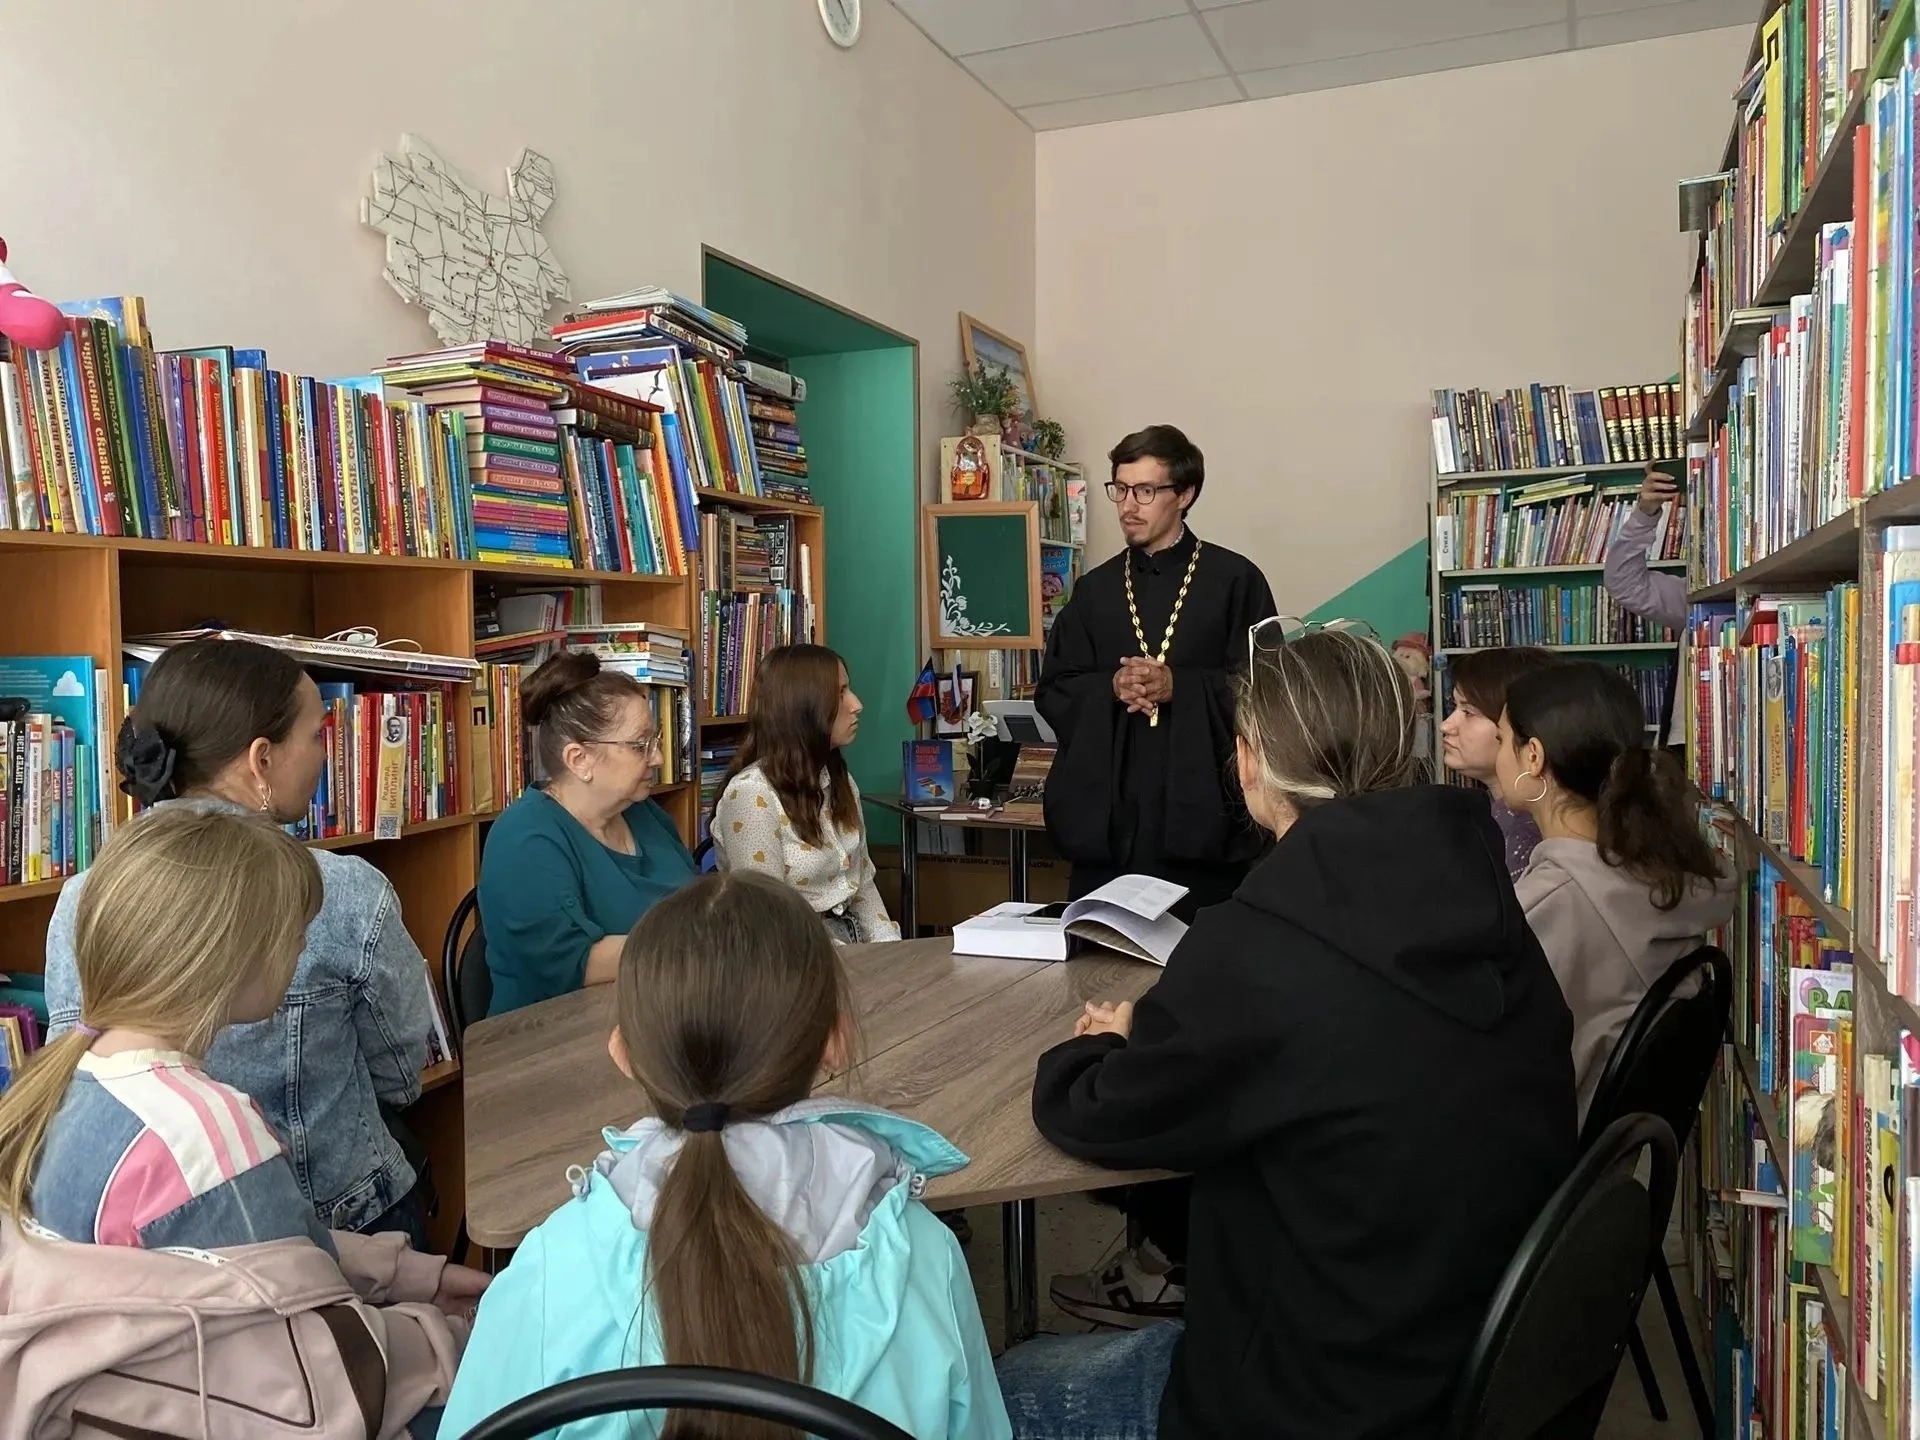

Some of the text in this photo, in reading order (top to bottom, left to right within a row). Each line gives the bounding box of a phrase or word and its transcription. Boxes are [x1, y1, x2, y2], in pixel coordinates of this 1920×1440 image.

[99, 328, 112, 378] СКАЗОК
[506, 343, 527, 355] Наши
[40, 360, 53, 396] КНИГА
[46, 399, 59, 441] ПЕРВАЯ
[106, 381, 120, 435] РУССКИХ
[53, 444, 63, 467] МОЯ
[94, 426, 113, 485] сказки
[343, 398, 361, 535] ЗОЛОТЫЕ СКАЗКИ
[336, 461, 345, 508] СКАЗОК
[402, 497, 410, 535] СКАЗКИ
[1440, 530, 1449, 553] Стихи
[473, 706, 486, 726] П
[16, 735, 24, 752] ПЭН
[1770, 723, 1785, 776] НОСОВ
[15, 755, 23, 784] ПИТЕР
[381, 765, 390, 800] Редьярд
[387, 760, 400, 808] КИПЛИНГ
